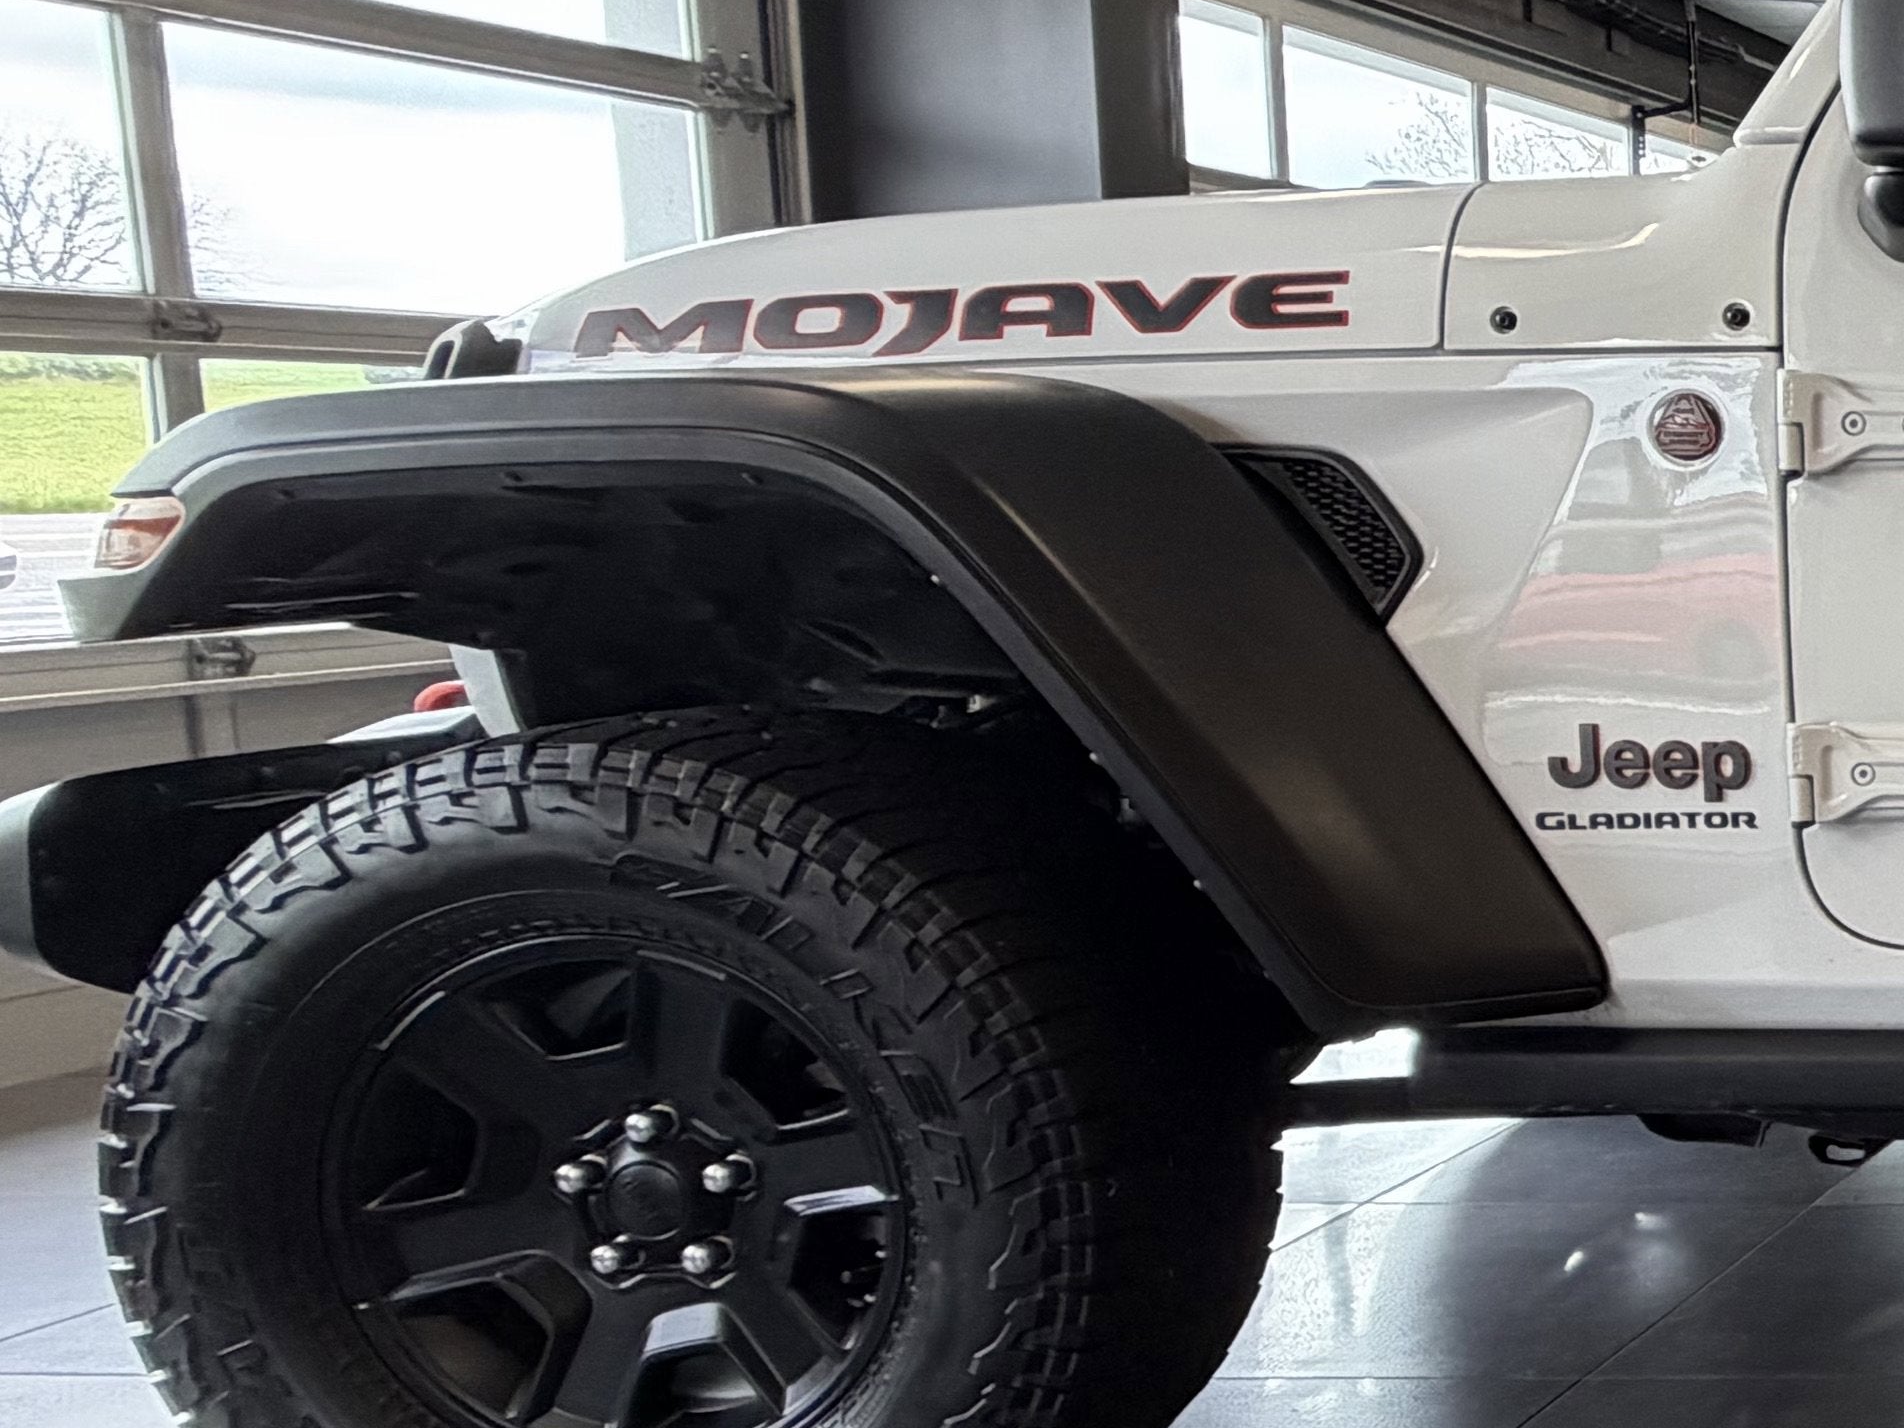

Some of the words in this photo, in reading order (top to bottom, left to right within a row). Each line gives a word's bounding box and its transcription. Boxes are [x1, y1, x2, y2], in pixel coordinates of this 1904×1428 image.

[574, 270, 1350, 358] MOJAVE
[1548, 723, 1751, 802] Jeep
[1536, 811, 1759, 830] GLADIATOR
